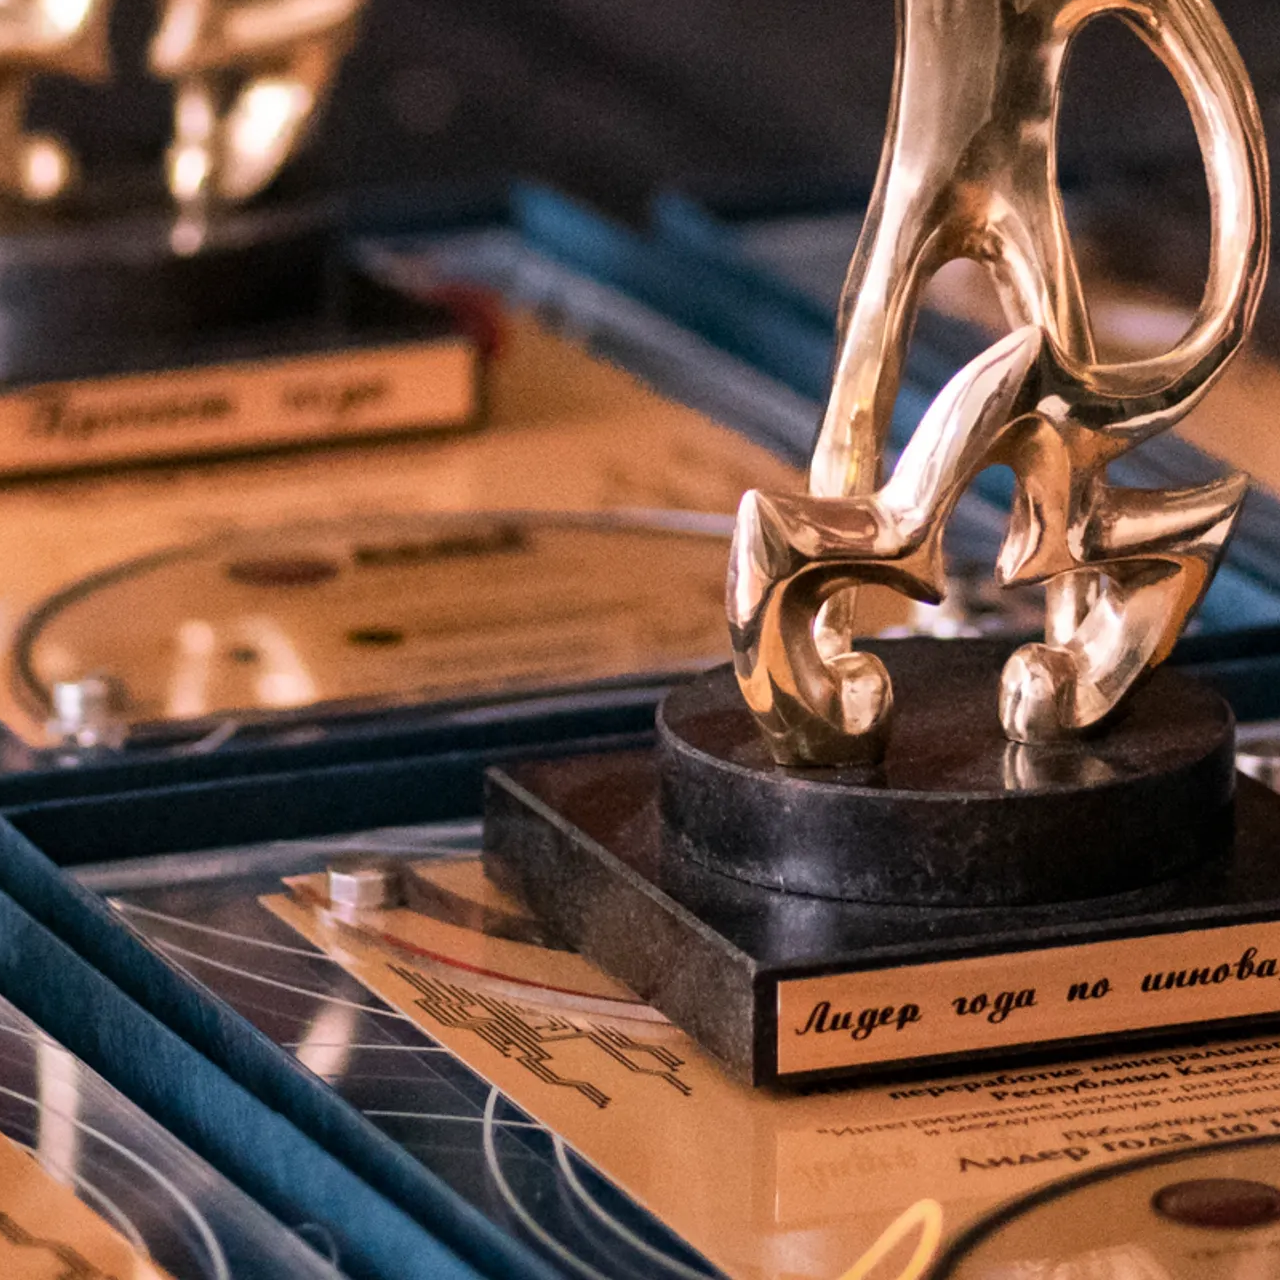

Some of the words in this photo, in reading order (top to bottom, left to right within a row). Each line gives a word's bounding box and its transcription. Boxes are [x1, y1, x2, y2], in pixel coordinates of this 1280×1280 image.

[795, 1001, 922, 1040] Лидер
[951, 988, 1037, 1023] года
[1067, 977, 1112, 1002] по
[888, 1068, 1083, 1100] переработке
[989, 1070, 1171, 1101] Республики
[1062, 1086, 1168, 1106] научных
[923, 1127, 941, 1137] и
[948, 1099, 1161, 1133] международную
[958, 1146, 1091, 1173] Лидер
[1102, 1132, 1194, 1152] года
[1205, 1122, 1259, 1139] по
